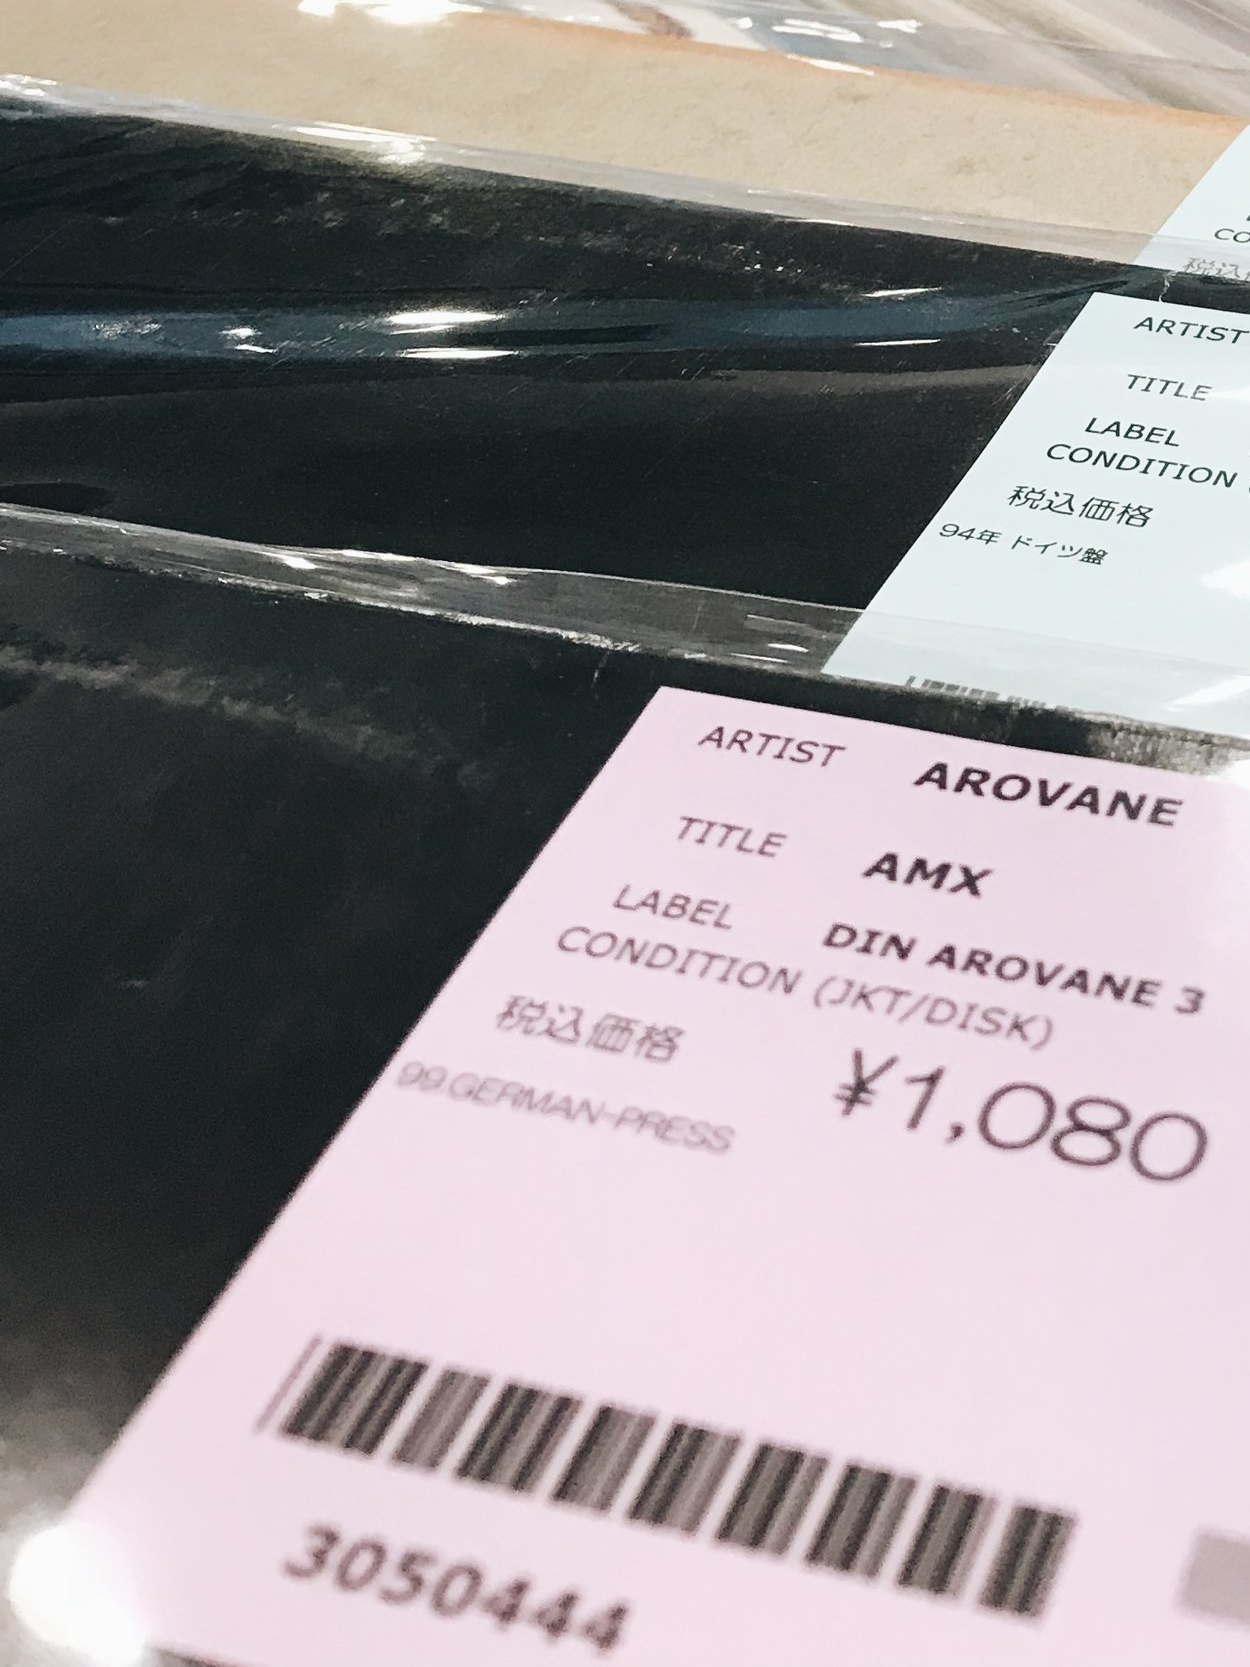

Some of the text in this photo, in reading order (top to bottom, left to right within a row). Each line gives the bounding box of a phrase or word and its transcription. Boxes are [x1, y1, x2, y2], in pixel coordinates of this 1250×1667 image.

[1133, 316, 1250, 345] ARTIST
[1126, 374, 1213, 402] TITLE
[1084, 417, 1181, 448] LABEL
[1045, 443, 1238, 490] CONDITION
[1007, 485, 1154, 528] 税込価格
[939, 523, 1108, 565] 94年 ドイツ盤
[698, 727, 1185, 828] ARTIST AROVANE
[675, 812, 994, 898] TITLE AMX
[612, 883, 1205, 1015] LABEL DIN AROVANE 3
[557, 926, 801, 997] CONDITION
[811, 974, 1055, 1051] (JKT/DISK)
[497, 995, 1209, 1182] 税込価格 ¥1,080
[281, 1522, 629, 1652] 3050444
